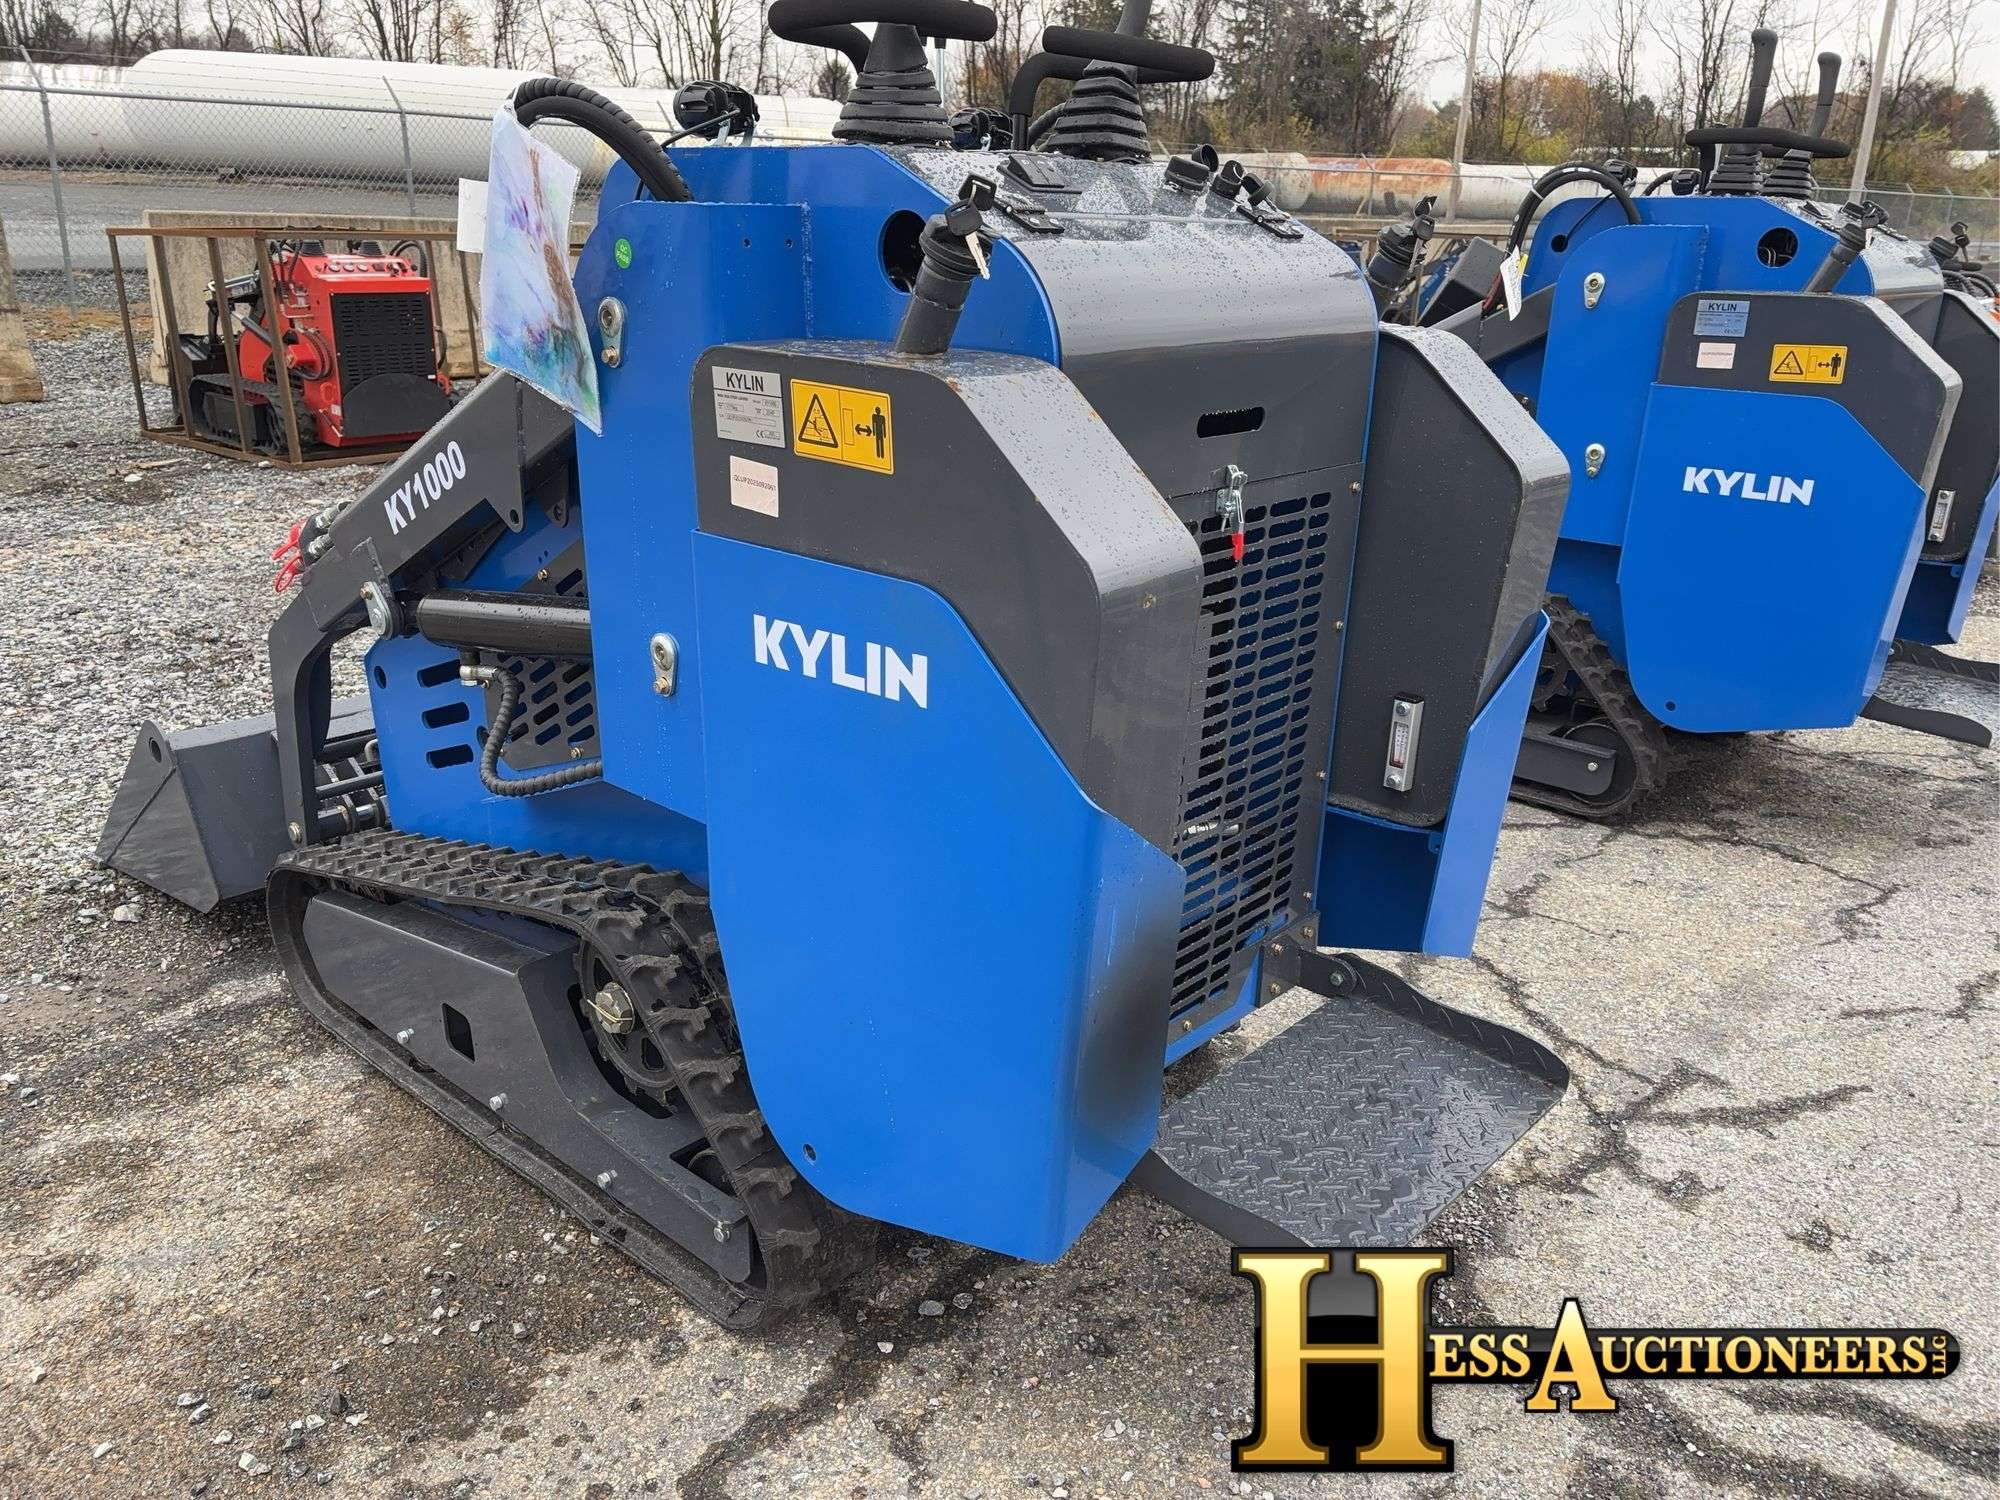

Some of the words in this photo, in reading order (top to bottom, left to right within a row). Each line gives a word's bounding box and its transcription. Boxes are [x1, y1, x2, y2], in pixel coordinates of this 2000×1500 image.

[1707, 302, 1738, 312] KYLIN
[725, 372, 764, 393] KYLIN
[383, 440, 466, 536] KY1000
[1682, 466, 1815, 506] KYLIN
[753, 613, 928, 710] KYLIN
